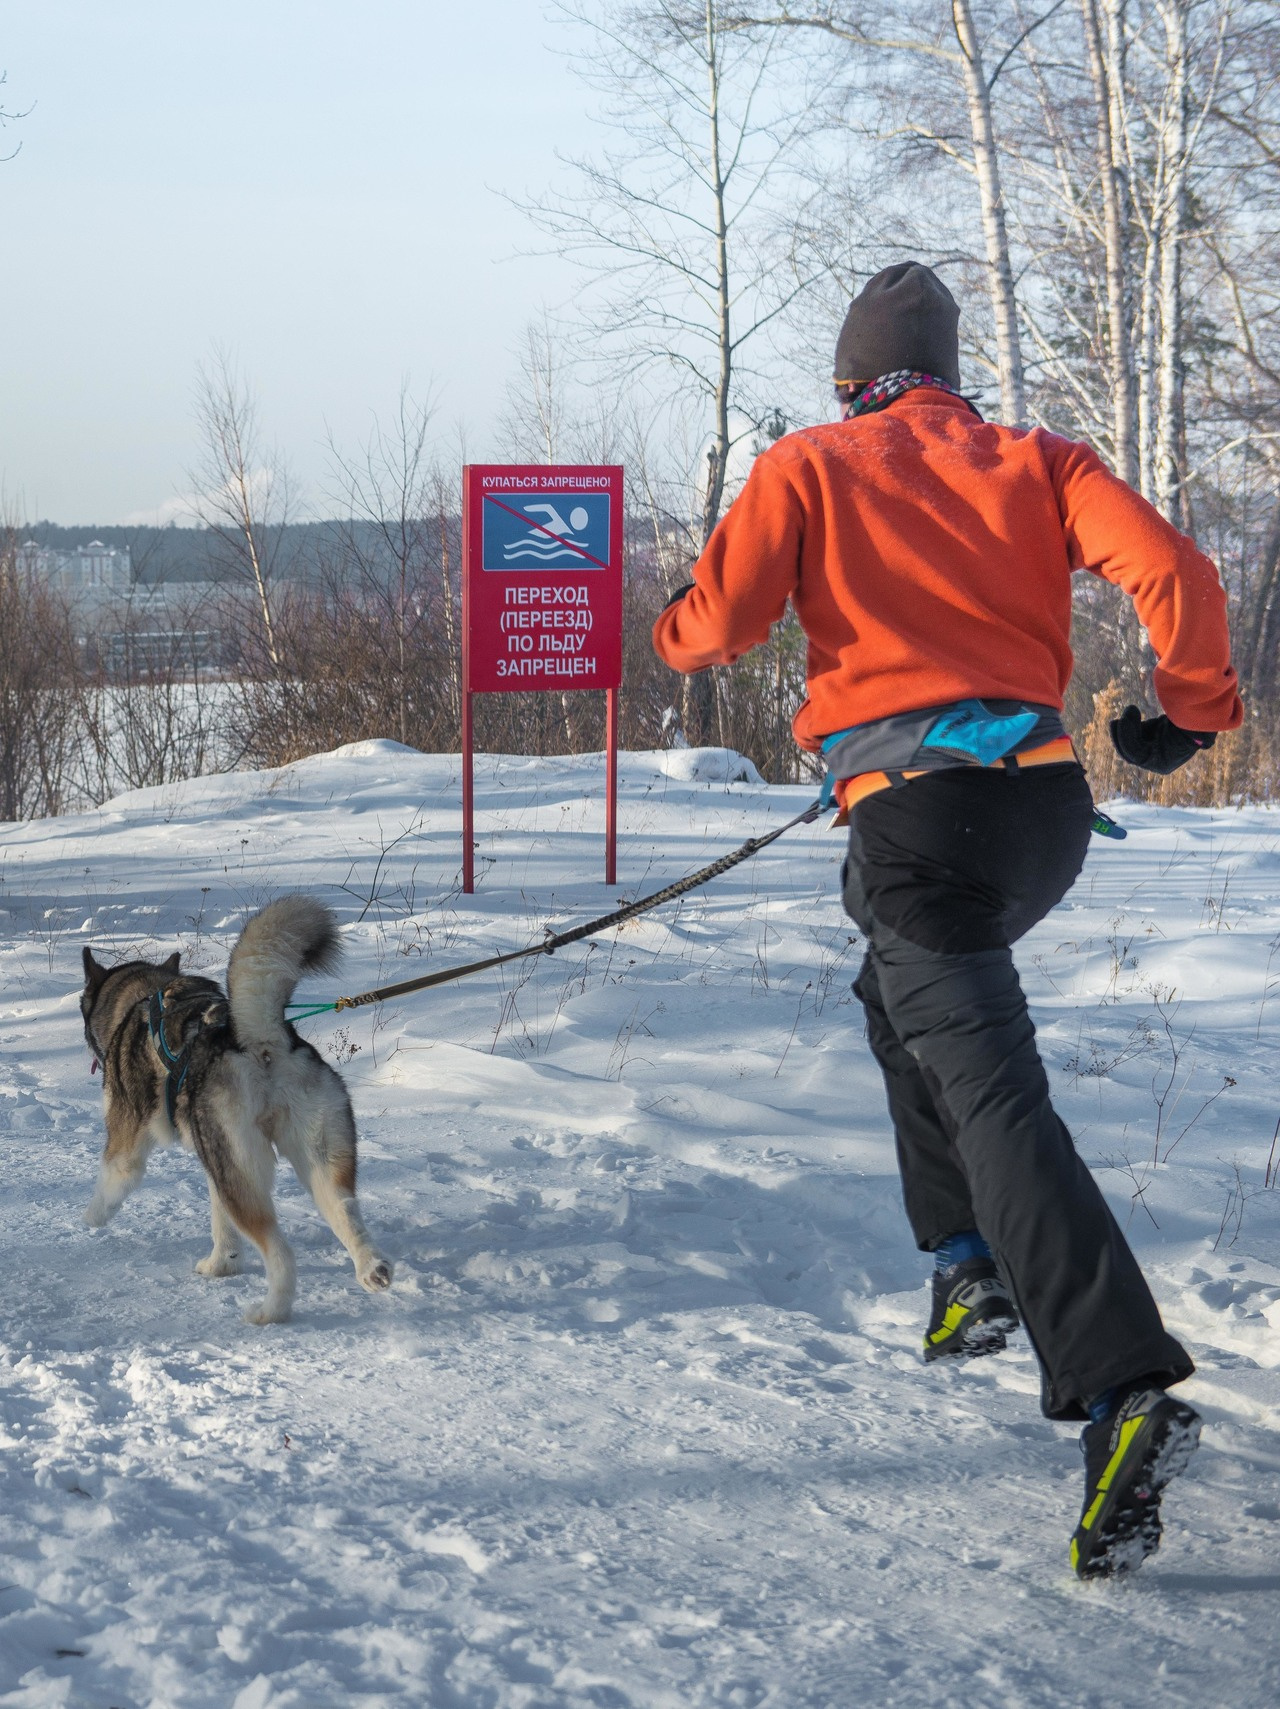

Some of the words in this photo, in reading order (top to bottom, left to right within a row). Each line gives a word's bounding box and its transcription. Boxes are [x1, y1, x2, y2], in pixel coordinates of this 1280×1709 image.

[482, 476, 538, 488] КУПАТЬСЯ
[541, 476, 611, 489] ЗАПРЕЩЕНО!
[505, 587, 589, 606] ПЕРЕХОД
[500, 610, 593, 632] (ПЕРЕЕЗД)
[508, 635, 534, 652] ПО
[538, 634, 586, 654] ЛЬДУ
[496, 657, 597, 677] ЗАПРЕЩЕН
